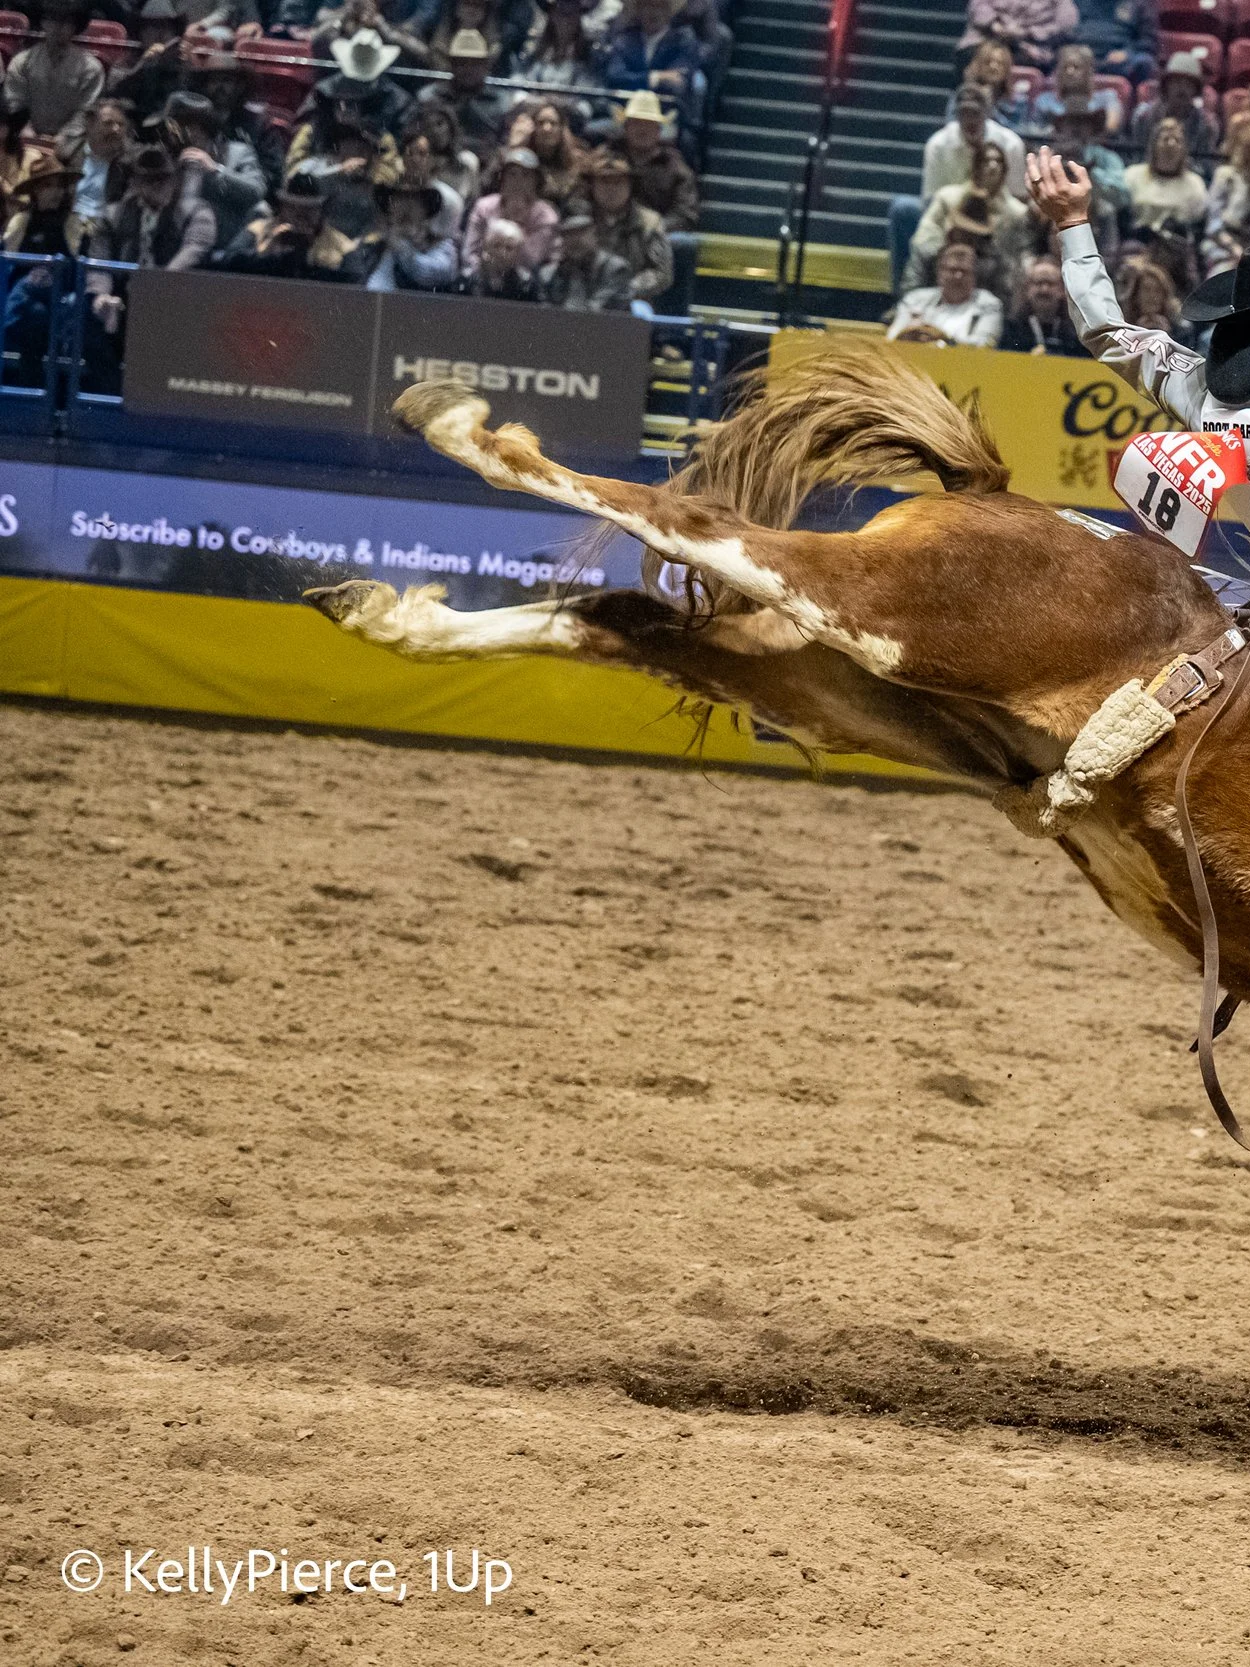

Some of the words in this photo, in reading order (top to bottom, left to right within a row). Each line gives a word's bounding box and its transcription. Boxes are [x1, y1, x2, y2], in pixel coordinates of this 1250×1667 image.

[393, 354, 600, 400] HESSTON
[1134, 433, 1157, 457] LAS
[1152, 449, 1186, 489] VEGAS
[1183, 483, 1213, 515] 2025
[1137, 471, 1182, 531] 18
[1150, 432, 1226, 501] NFR
[70, 510, 192, 548] Subscribe
[197, 526, 225, 551] to
[230, 526, 348, 566] Cowboys
[352, 538, 374, 566] &
[380, 541, 472, 576] Indians
[477, 551, 606, 588] Magazine
